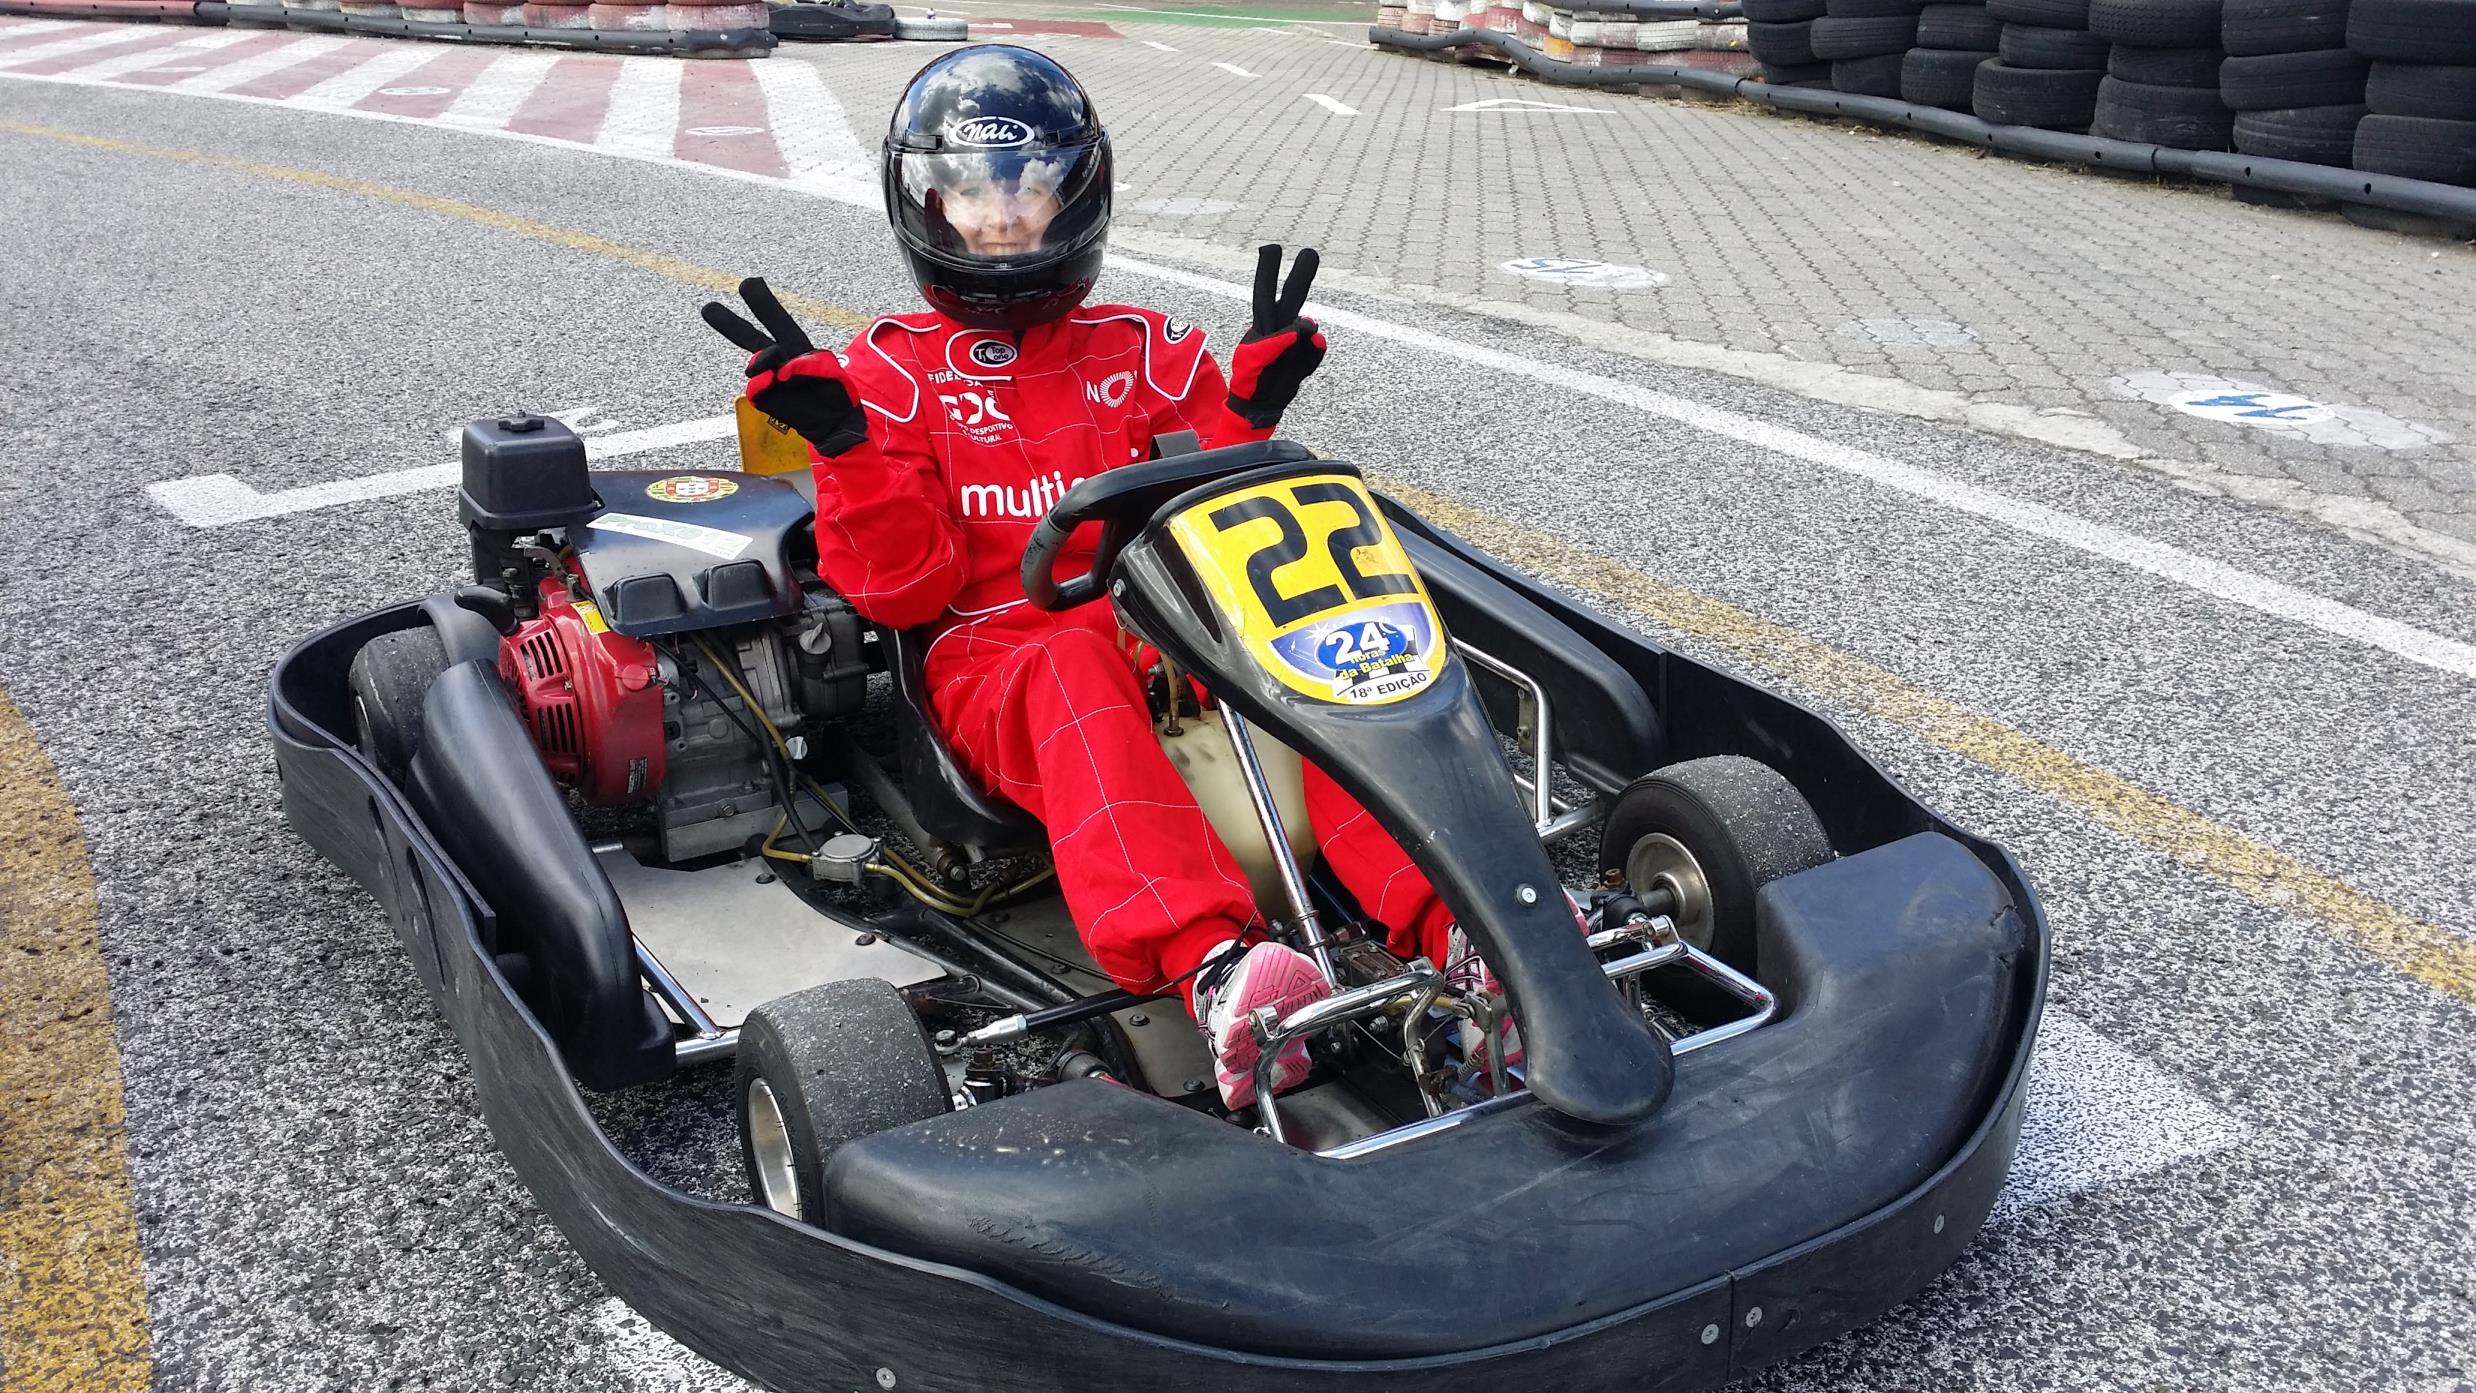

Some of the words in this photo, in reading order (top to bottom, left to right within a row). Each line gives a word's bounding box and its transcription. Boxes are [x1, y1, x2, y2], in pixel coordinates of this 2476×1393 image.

[990, 345, 1006, 355] Top
[1208, 482, 1419, 628] 22
[1325, 621, 1390, 665] 24
[1339, 668, 1359, 681] da
[1359, 653, 1414, 673] Batalha
[1377, 672, 1427, 694] EDIÇÃO
